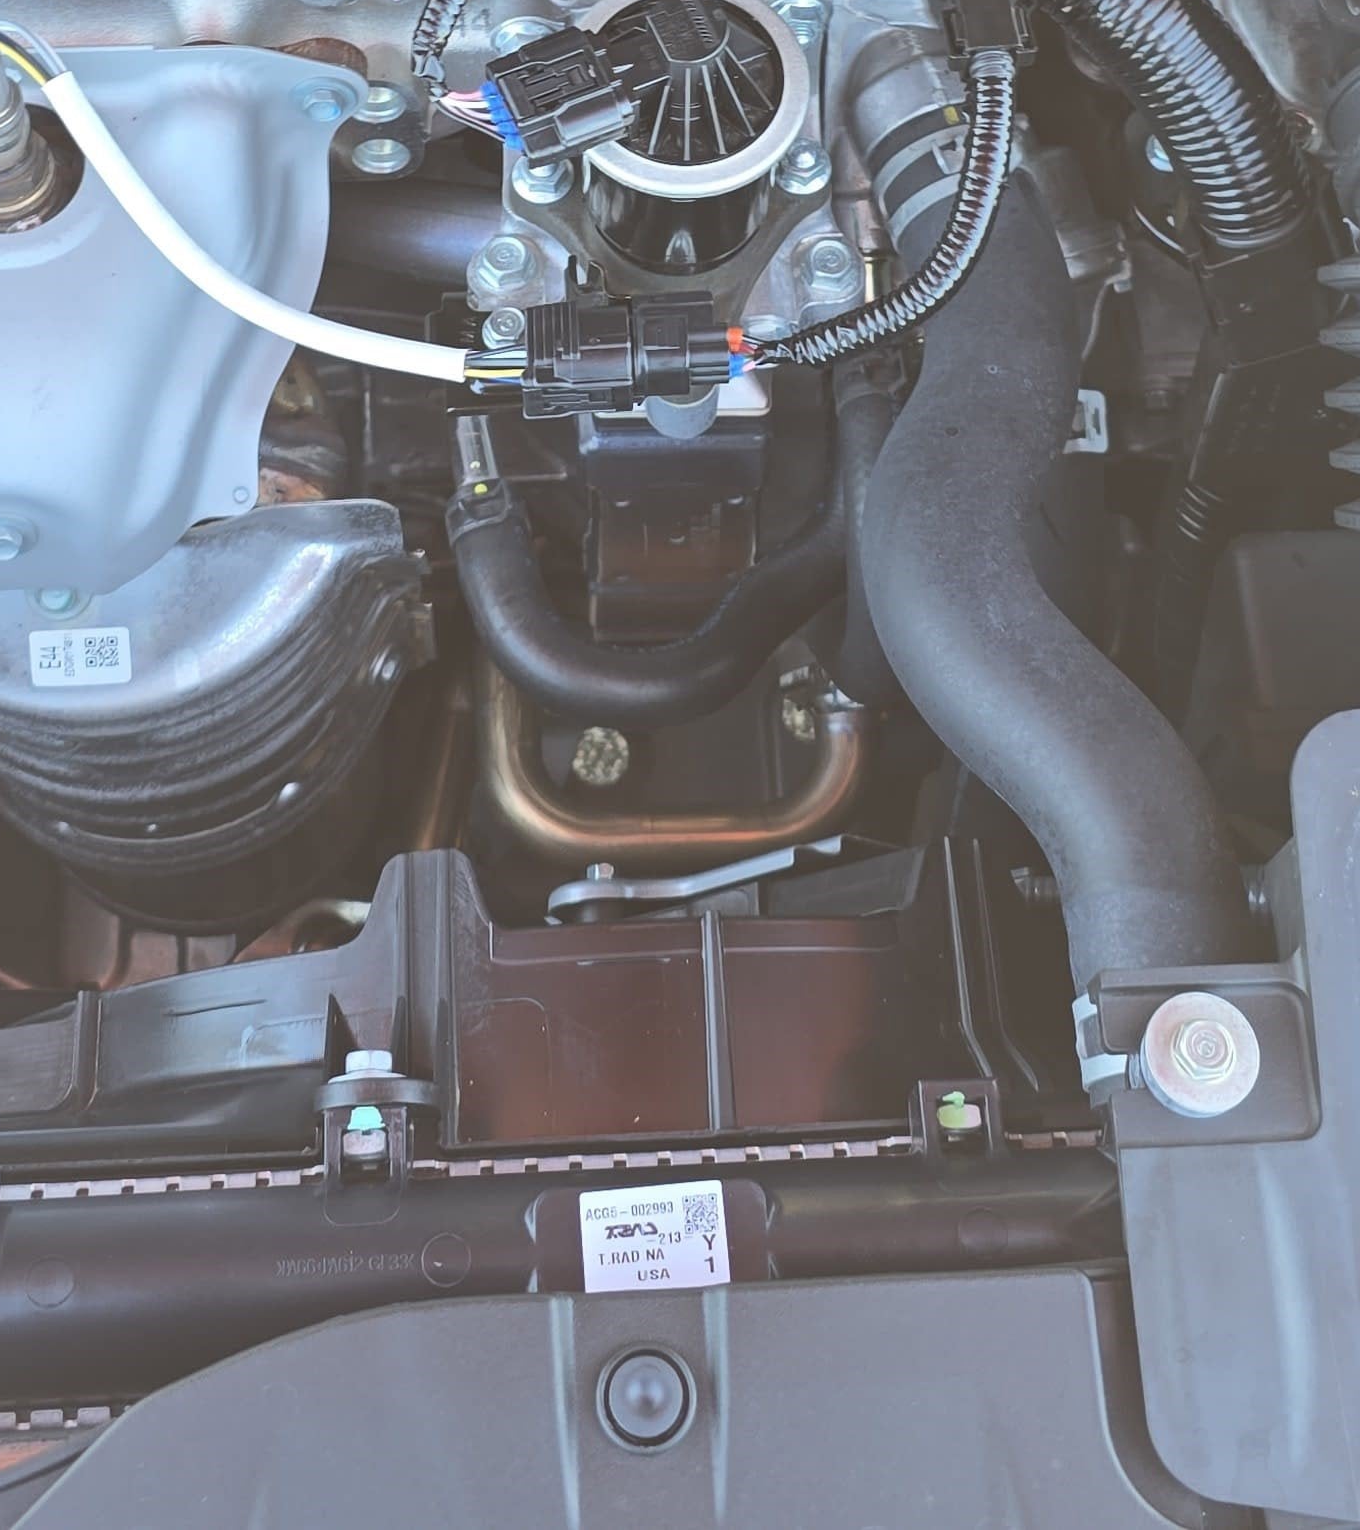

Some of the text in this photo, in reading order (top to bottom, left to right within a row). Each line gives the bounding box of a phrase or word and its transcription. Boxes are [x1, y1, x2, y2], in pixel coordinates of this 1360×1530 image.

[703, 1234, 716, 1251] Y
[599, 1248, 664, 1265] T.RAD NA
[705, 1256, 715, 1273] 1
[638, 1268, 670, 1281] USA
